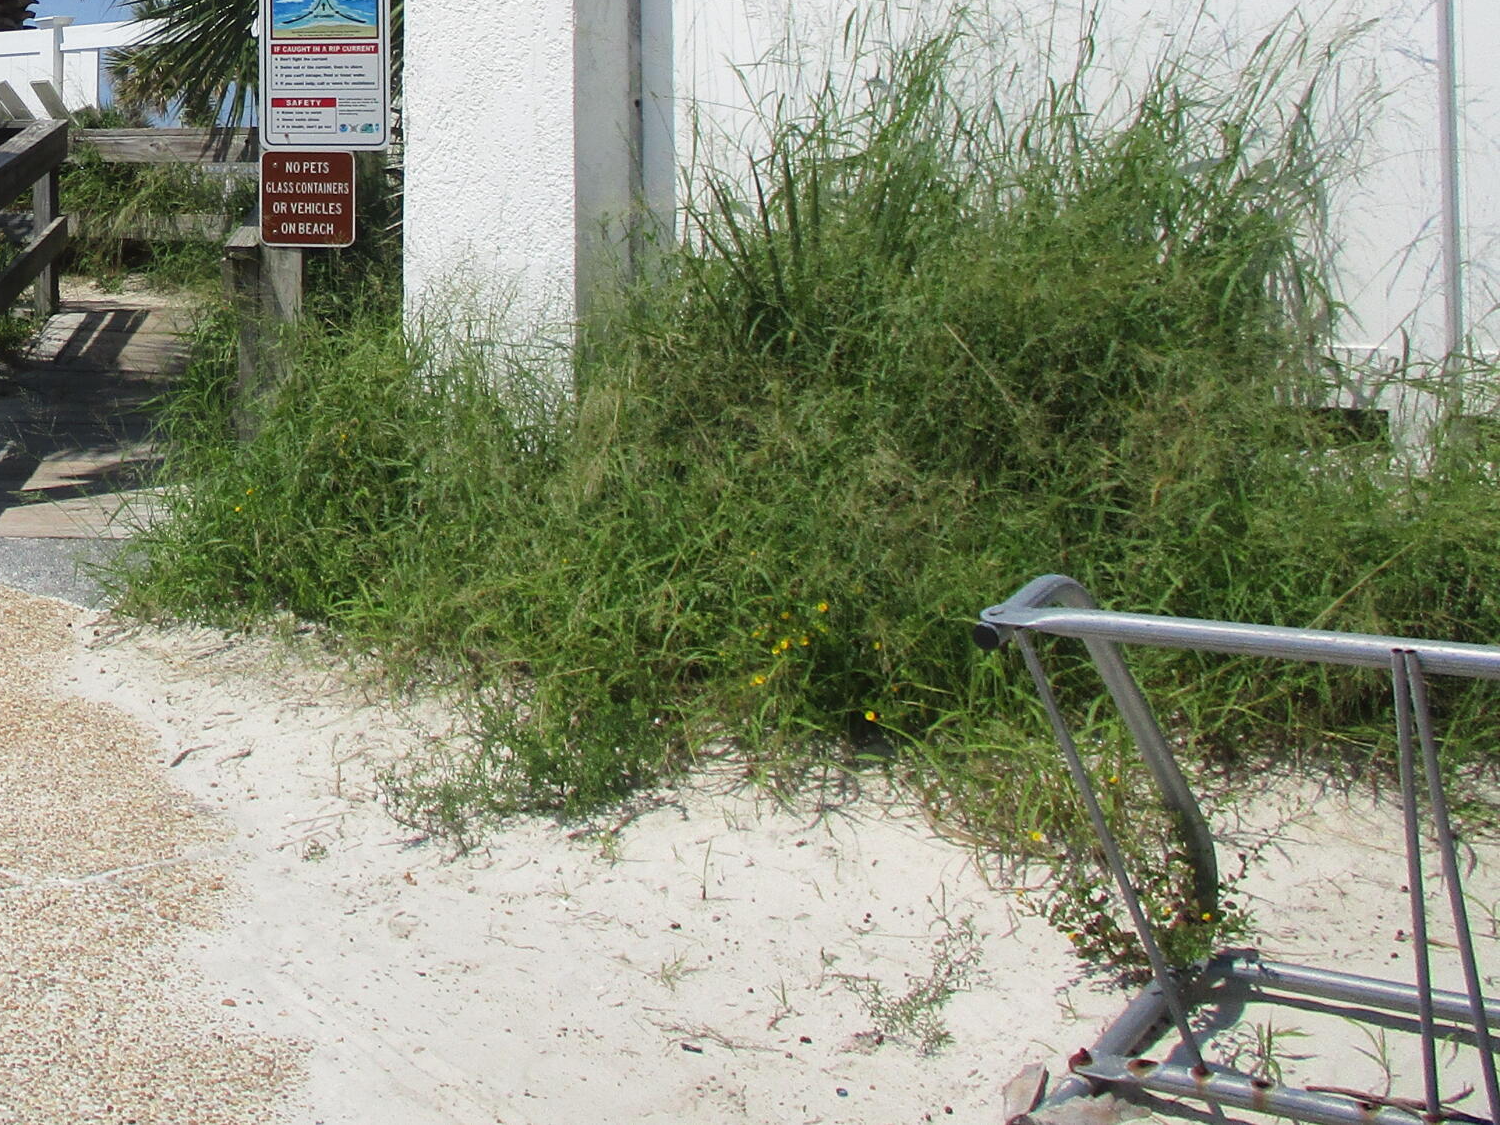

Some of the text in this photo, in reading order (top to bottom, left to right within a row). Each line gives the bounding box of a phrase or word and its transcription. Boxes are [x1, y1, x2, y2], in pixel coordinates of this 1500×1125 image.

[285, 161, 330, 174] NO PETS
[266, 182, 349, 194] GLASS CONTAINERS
[273, 202, 342, 215] OR VEHICLES
[281, 222, 334, 235] ON BEACH
